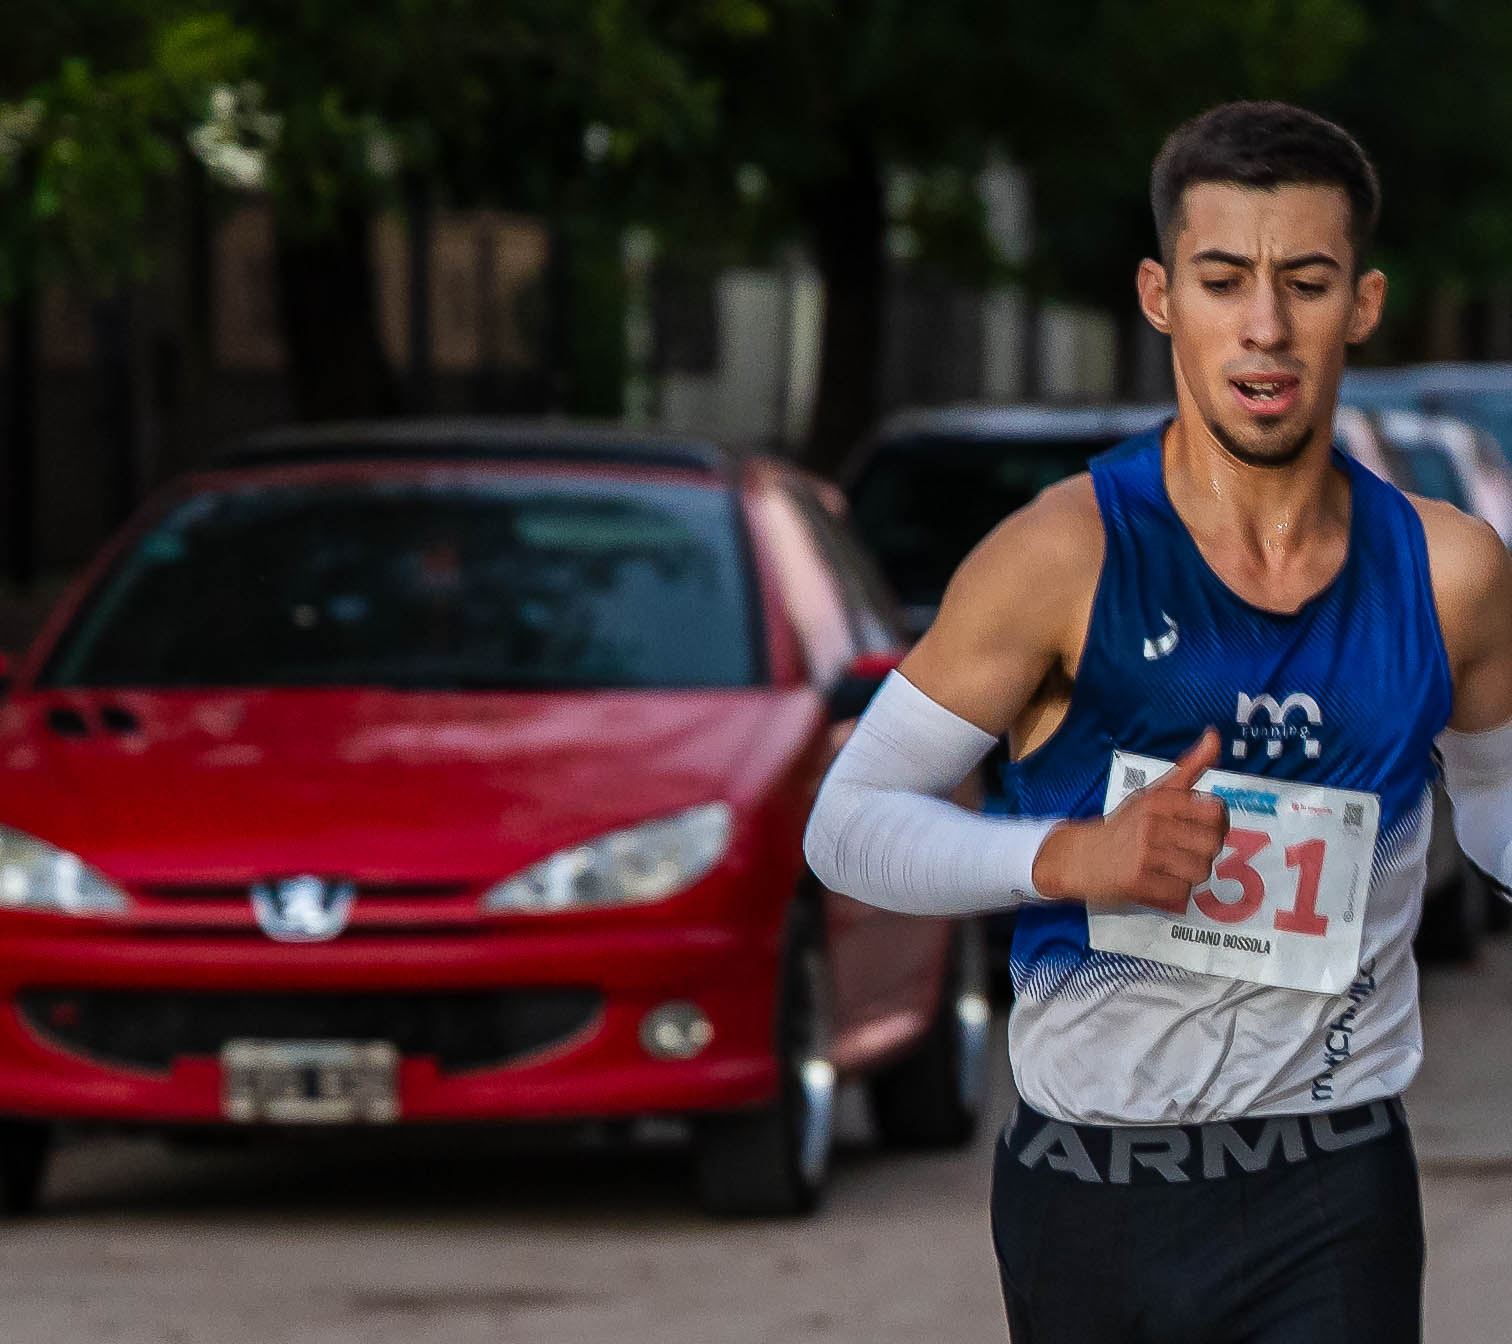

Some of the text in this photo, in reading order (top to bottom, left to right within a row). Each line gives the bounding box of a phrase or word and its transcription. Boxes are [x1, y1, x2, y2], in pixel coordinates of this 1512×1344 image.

[1241, 724, 1311, 742] running
[1136, 827, 1330, 937] 31
[1170, 924, 1271, 954] GIULIANO BOSSOLA
